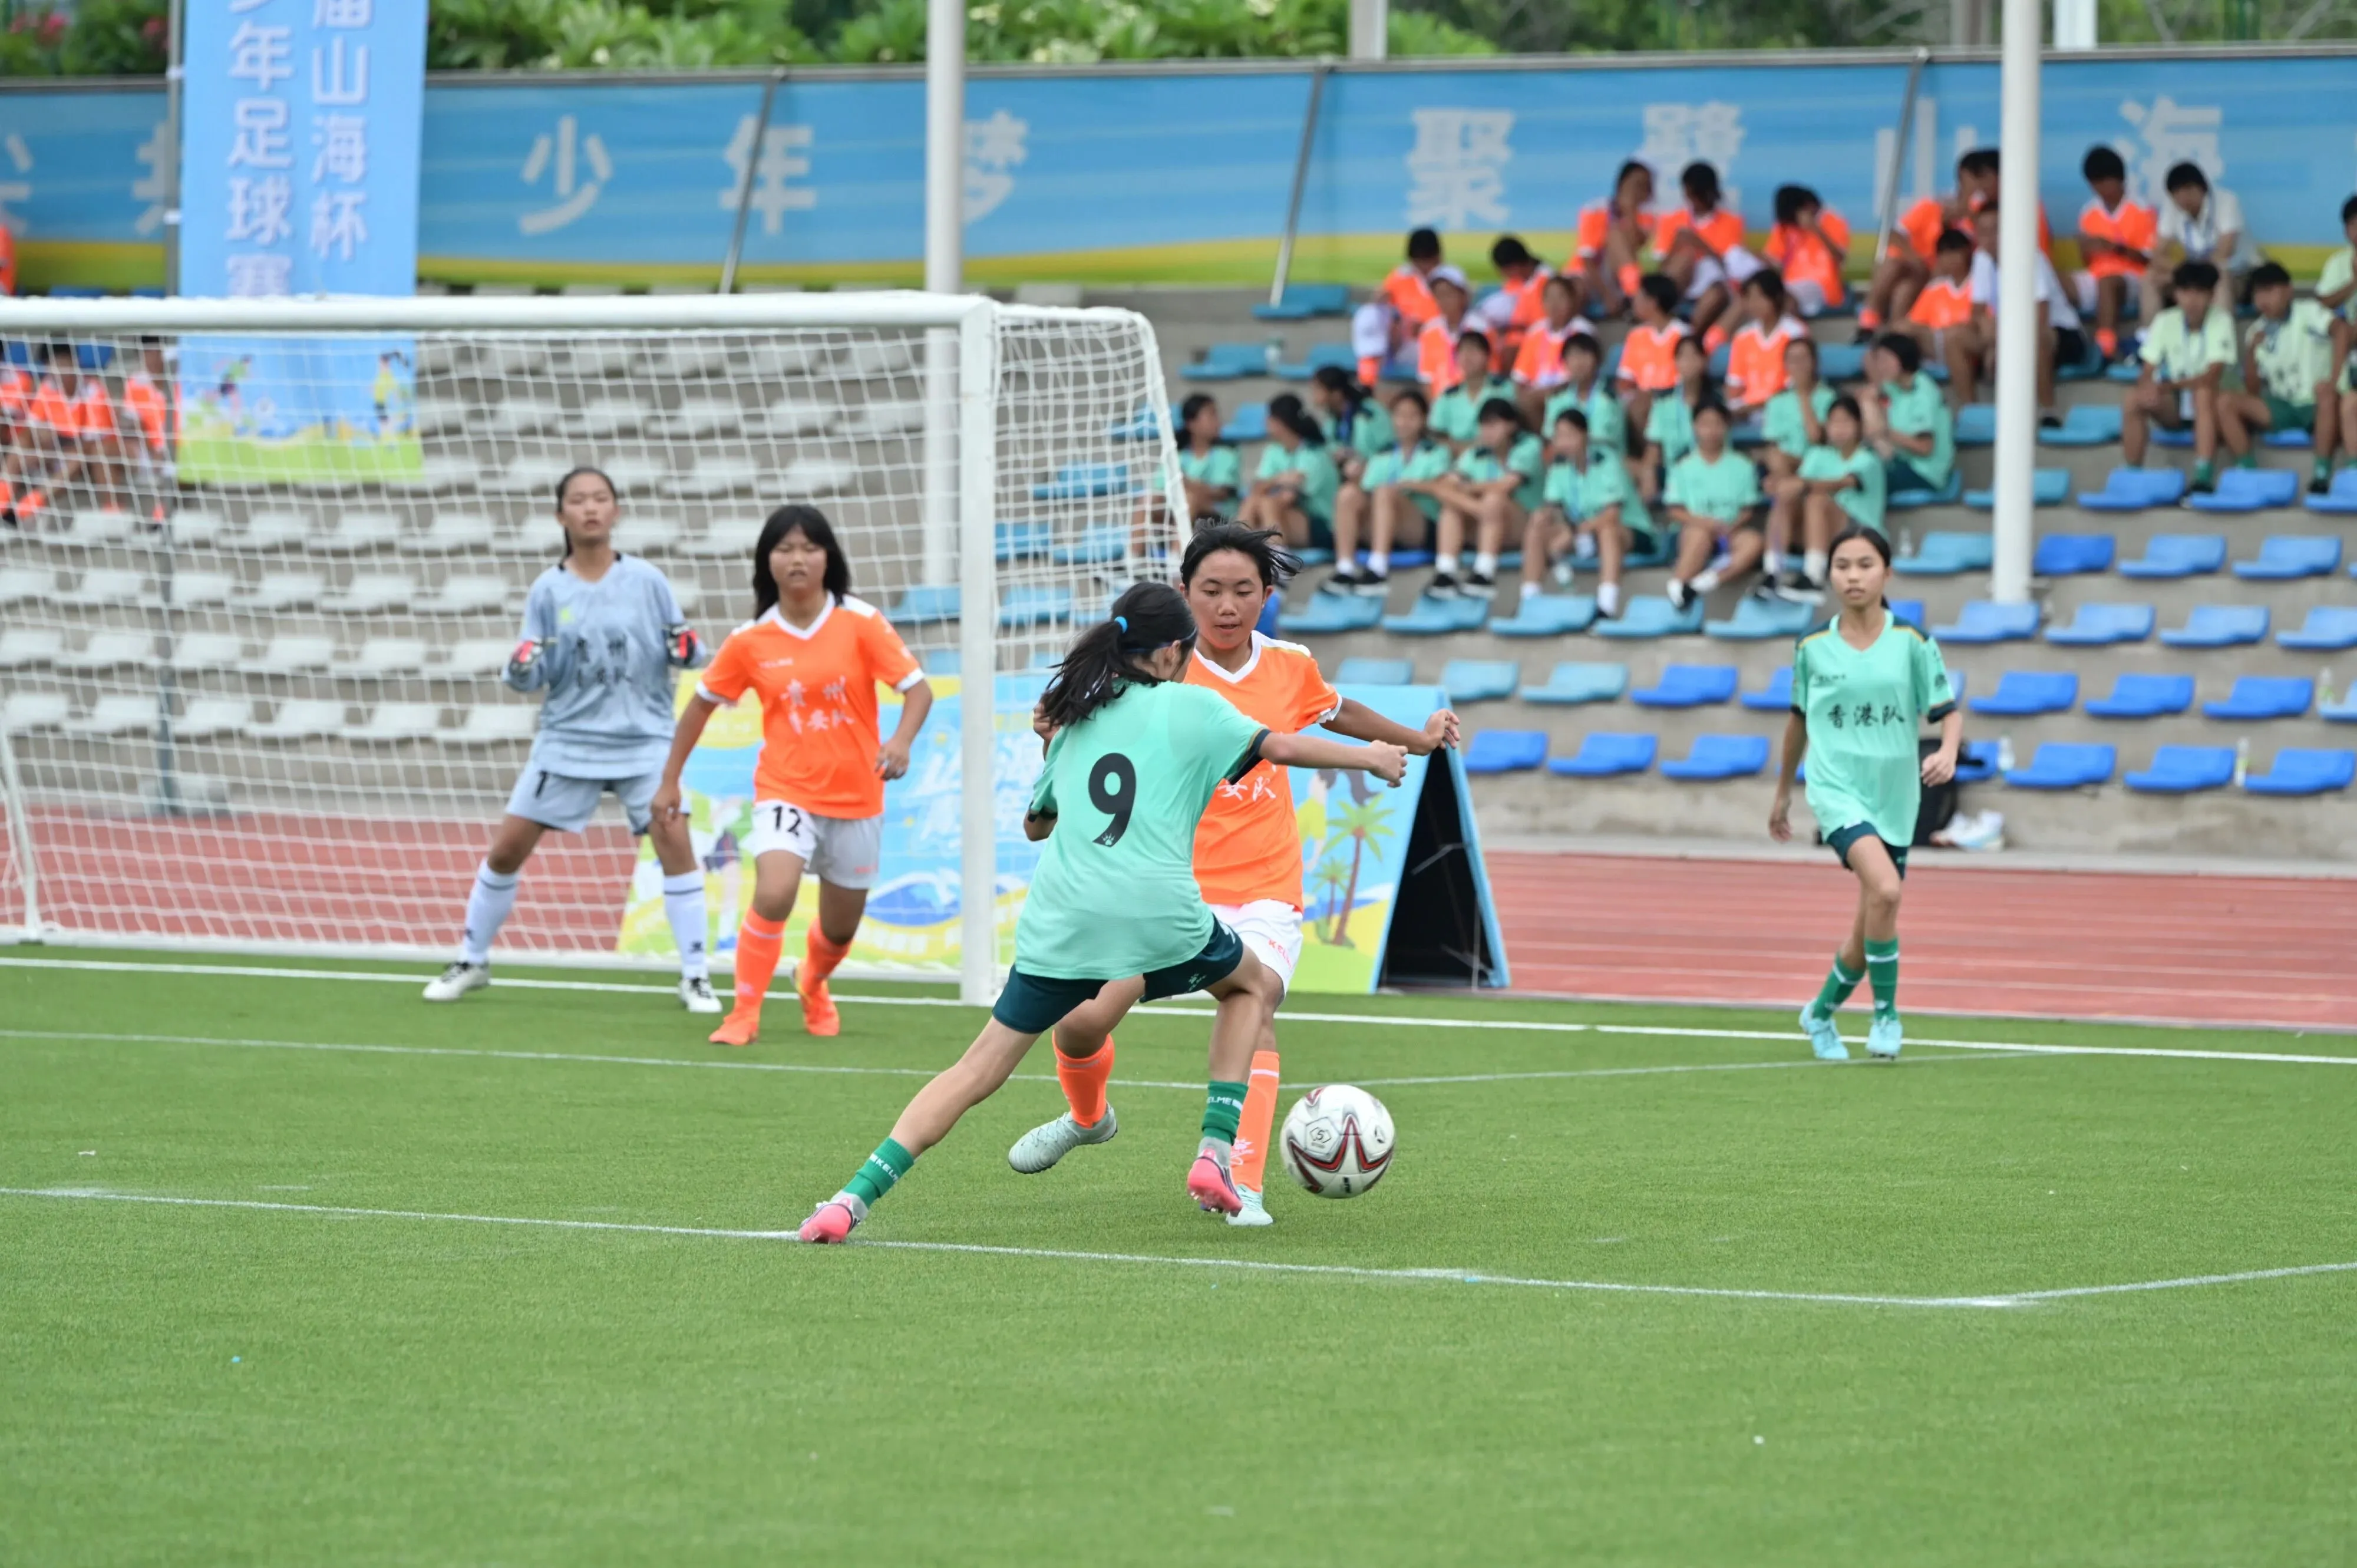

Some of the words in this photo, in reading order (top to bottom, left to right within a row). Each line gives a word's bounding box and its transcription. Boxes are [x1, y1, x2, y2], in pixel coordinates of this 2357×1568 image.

[224, 0, 295, 297] 年足球赛
[1827, 701, 1904, 730] 香港队
[772, 805, 801, 837] 12
[1088, 752, 1137, 848] 9
